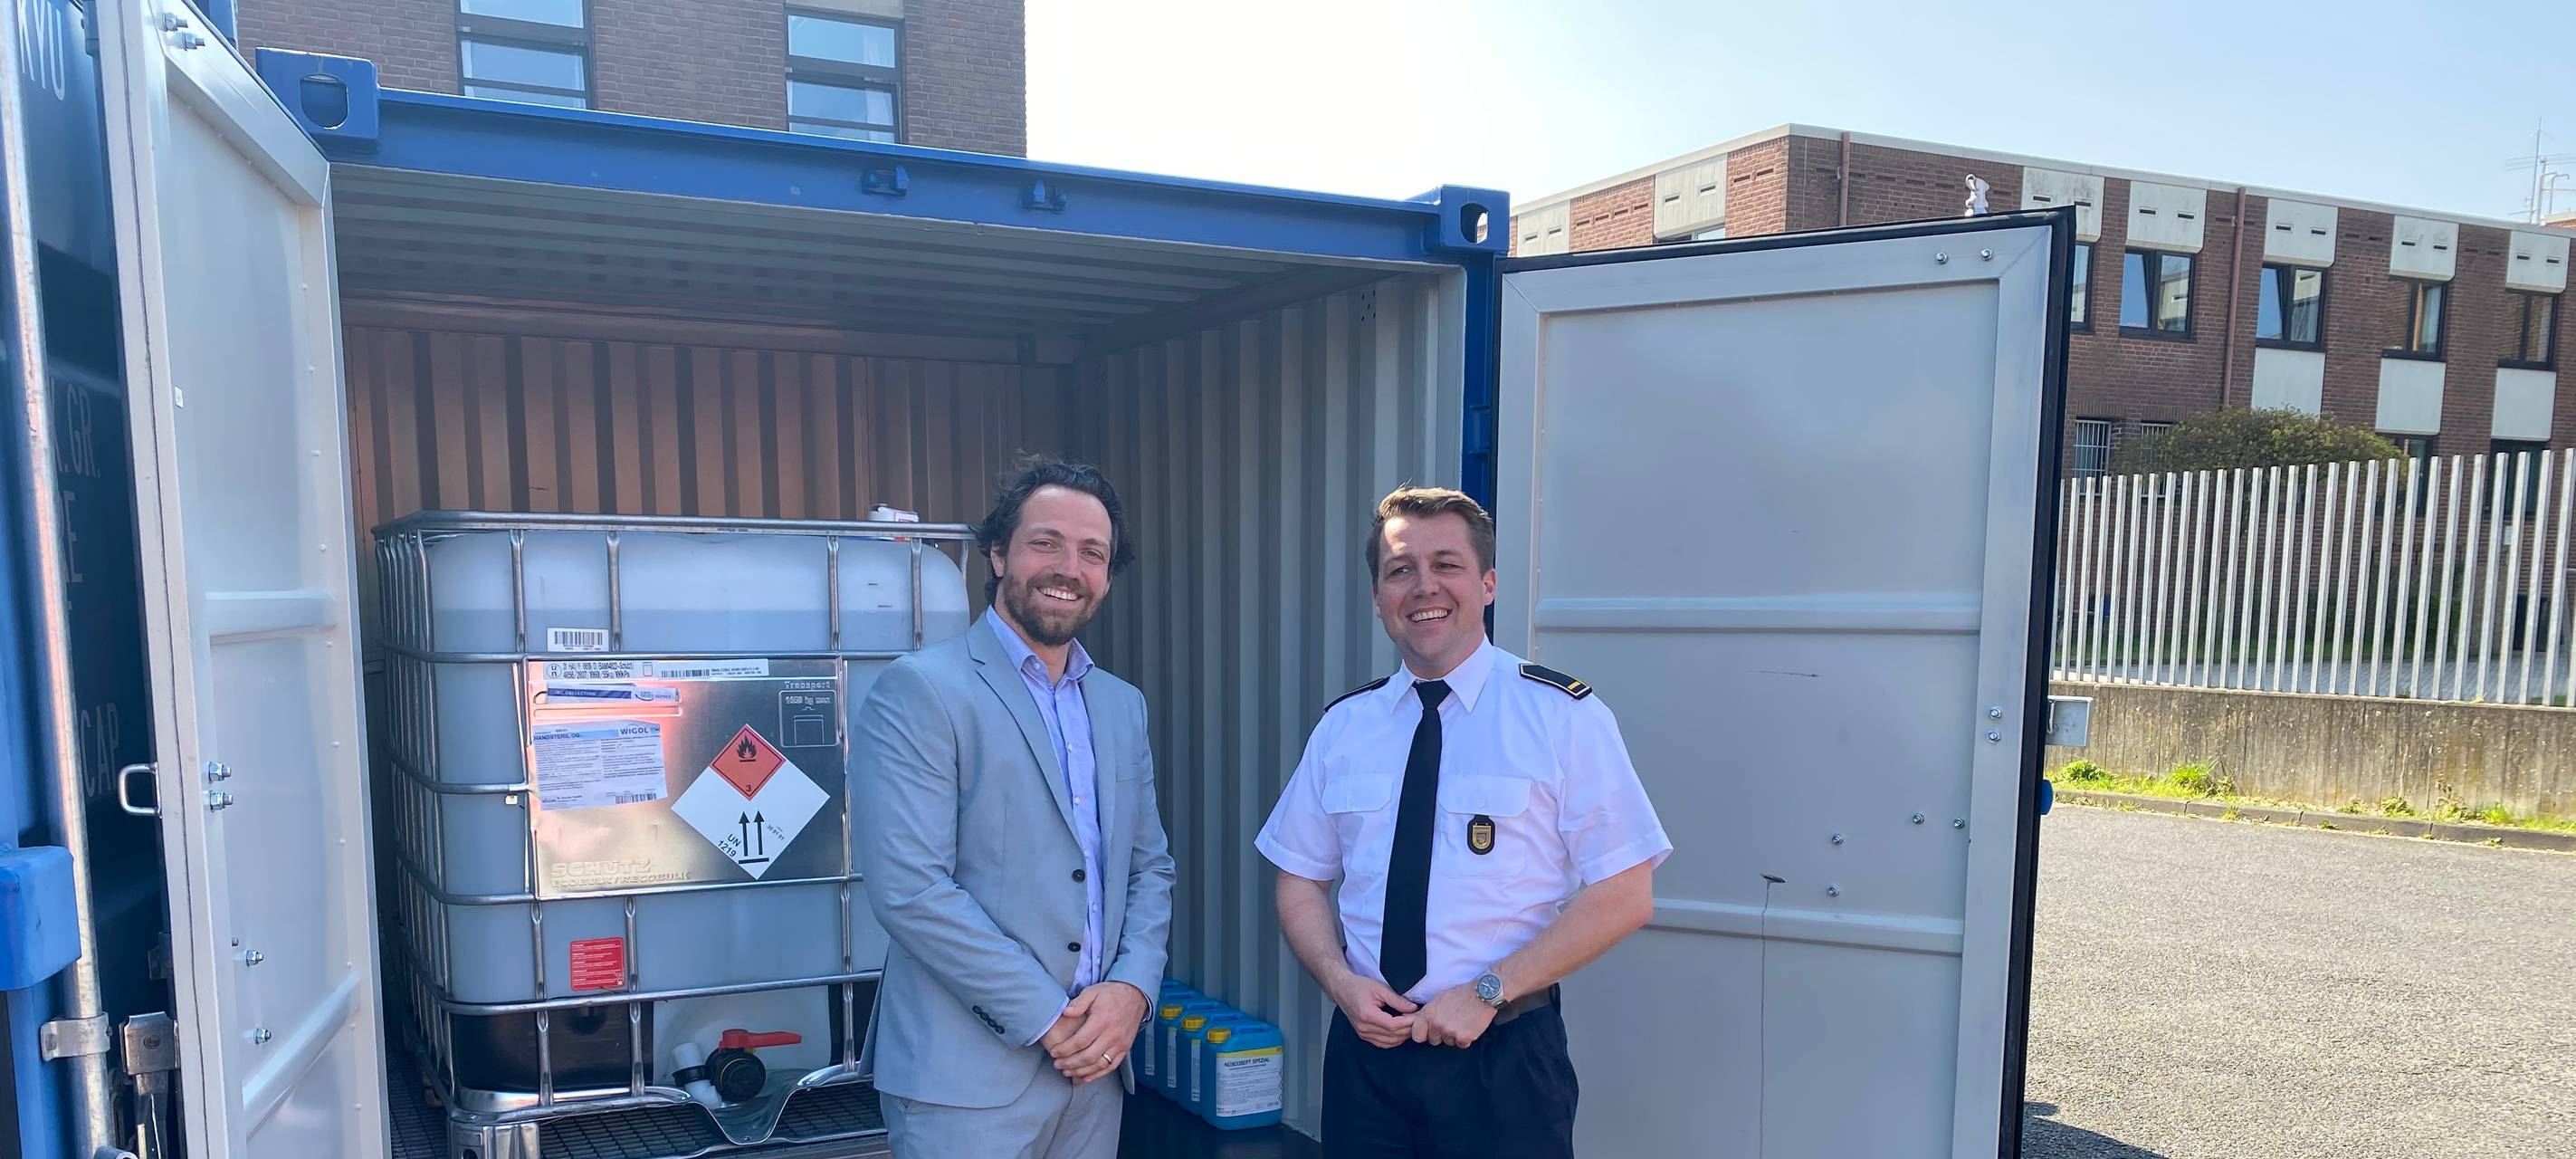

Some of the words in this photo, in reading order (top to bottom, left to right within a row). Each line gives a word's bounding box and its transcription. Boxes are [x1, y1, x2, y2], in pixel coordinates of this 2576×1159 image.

[784, 681, 831, 691] Transport
[620, 727, 649, 735] WIGOL
[80, 703, 119, 798] CAP
[745, 784, 752, 792] 3
[727, 833, 741, 848] UN
[718, 839, 737, 857] 1219
